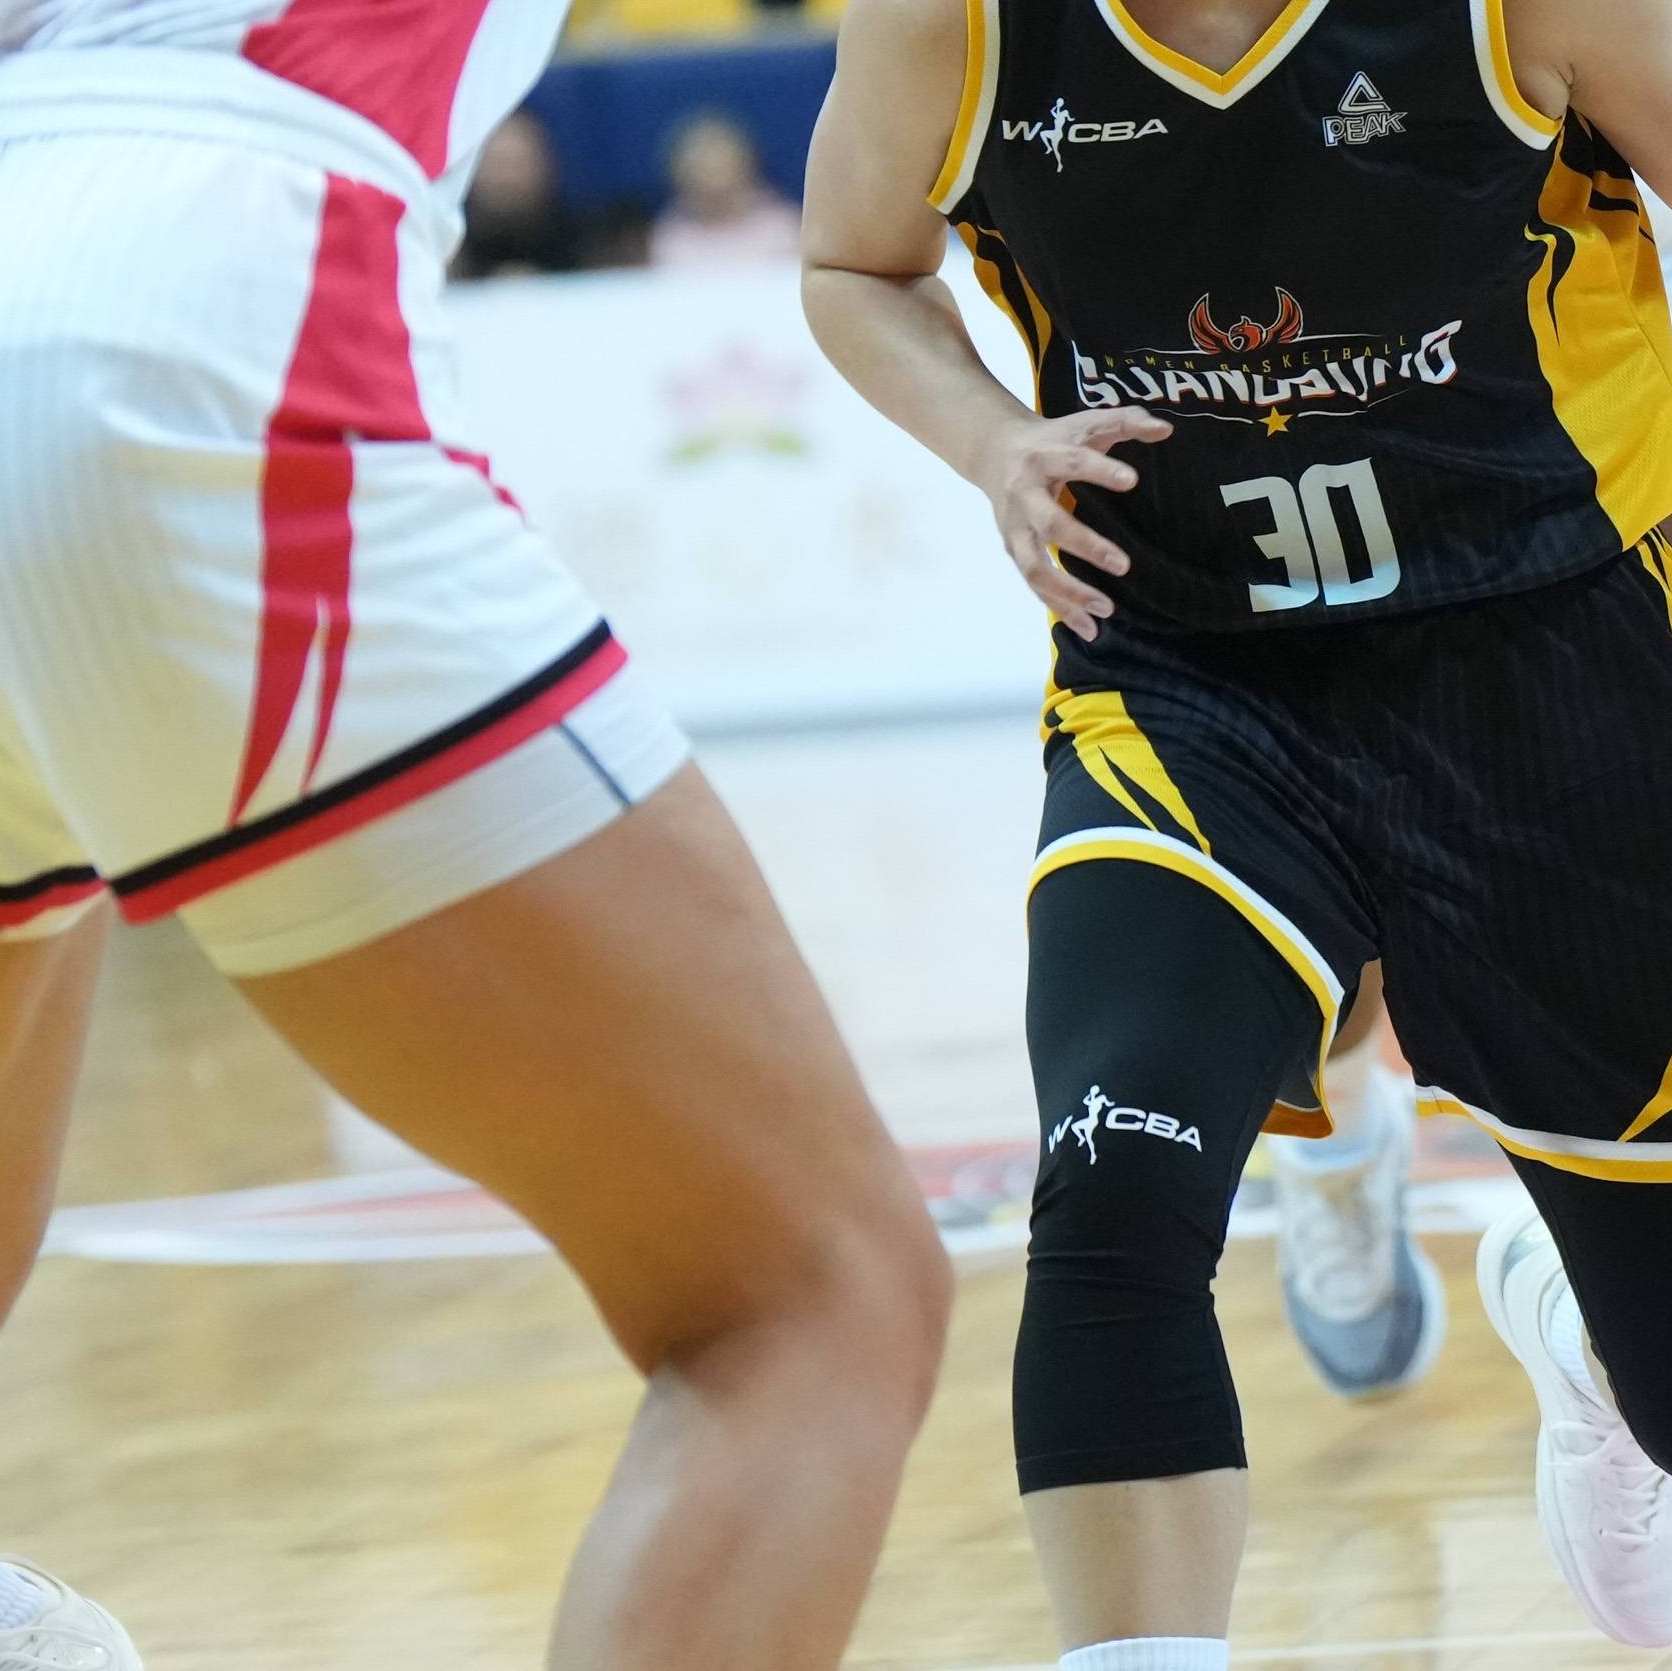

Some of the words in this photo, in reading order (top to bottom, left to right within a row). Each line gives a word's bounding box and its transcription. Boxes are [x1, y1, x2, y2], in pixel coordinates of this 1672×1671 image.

[1322, 111, 1409, 148] PEAK
[1220, 334, 1407, 373] BASKETBALL
[1219, 457, 1401, 613] 30
[1048, 1107, 1203, 1155] WCBA
